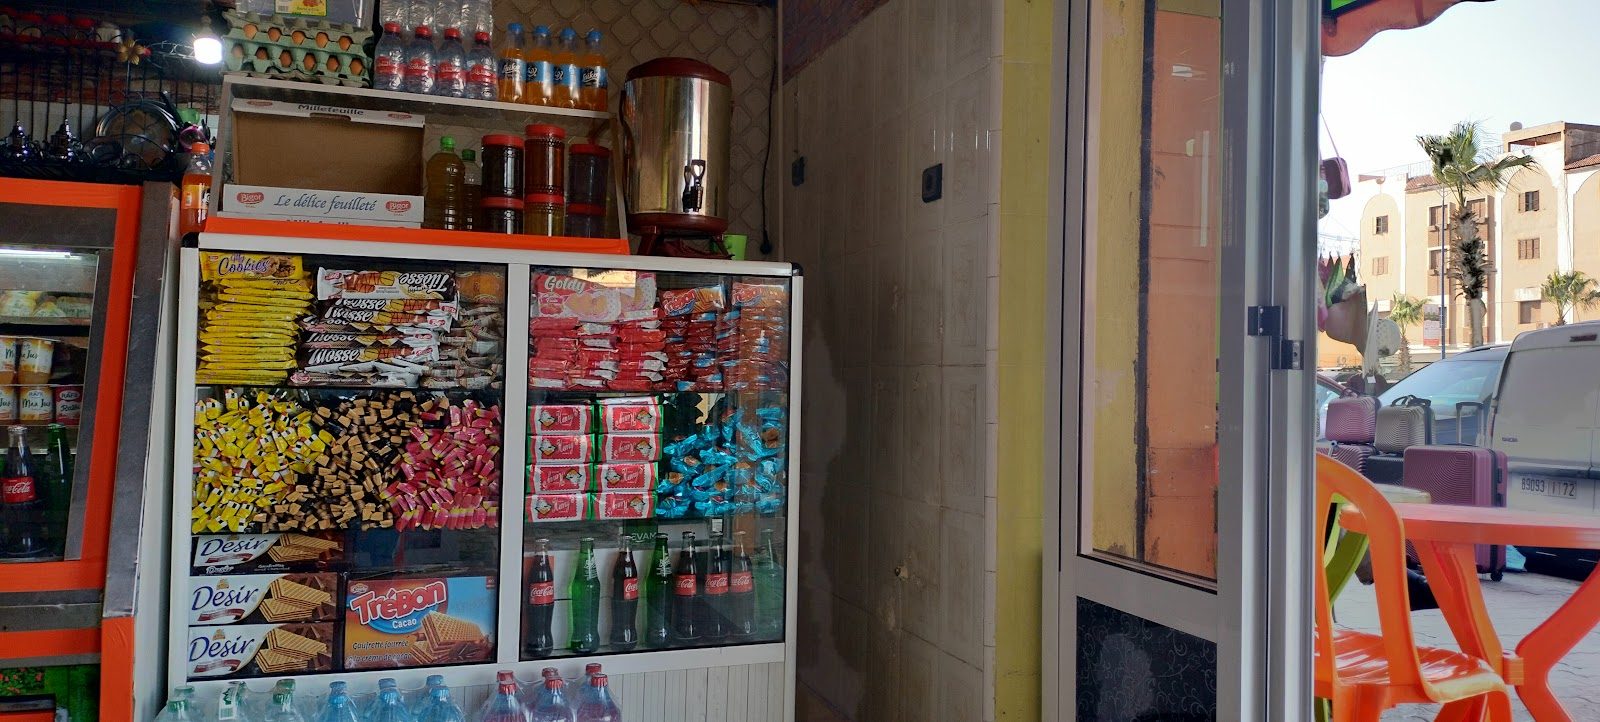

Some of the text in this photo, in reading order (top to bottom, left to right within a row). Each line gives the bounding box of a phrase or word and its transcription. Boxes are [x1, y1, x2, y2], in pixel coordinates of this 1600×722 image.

[297, 103, 364, 116] Millefeuille
[273, 193, 377, 214] Le délice feuilleté
[217, 257, 269, 276] Cookies
[544, 275, 586, 295] Goldy
[200, 537, 268, 557] Desir
[191, 584, 259, 611] Desir
[350, 581, 447, 626] TréBon
[392, 618, 418, 630] Cacao
[189, 635, 255, 662] Desir
